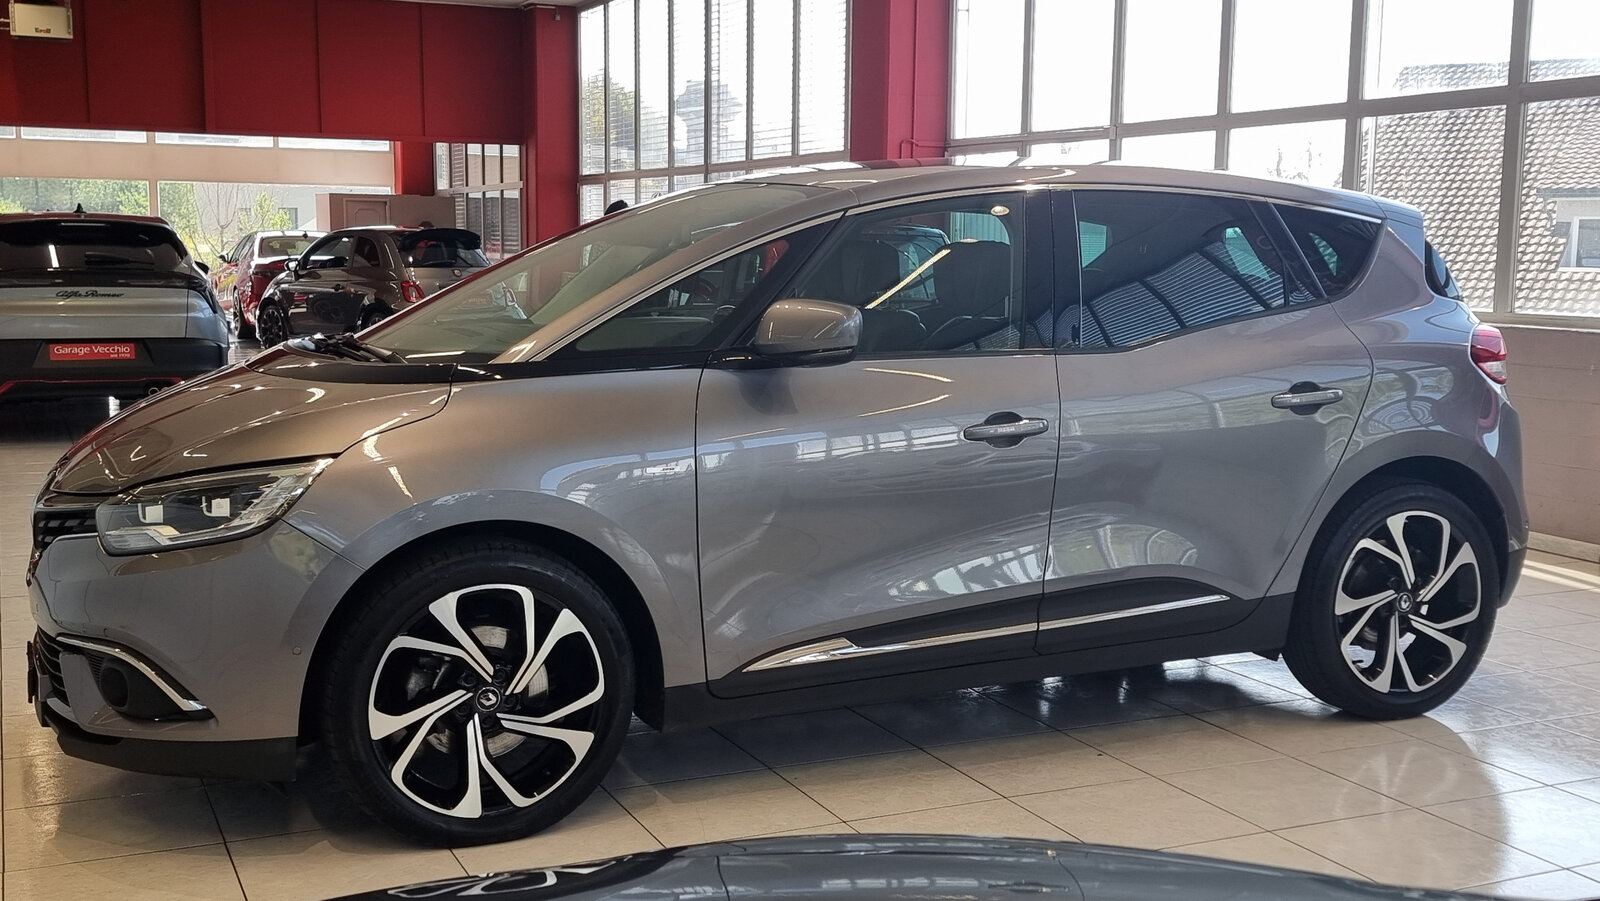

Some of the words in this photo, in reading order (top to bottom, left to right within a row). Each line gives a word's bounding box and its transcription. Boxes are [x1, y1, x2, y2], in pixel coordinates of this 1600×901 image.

[56, 290, 82, 299] Alfa
[83, 289, 124, 298] Romeo
[54, 345, 90, 355] Garage
[92, 345, 130, 354] Vecchio
